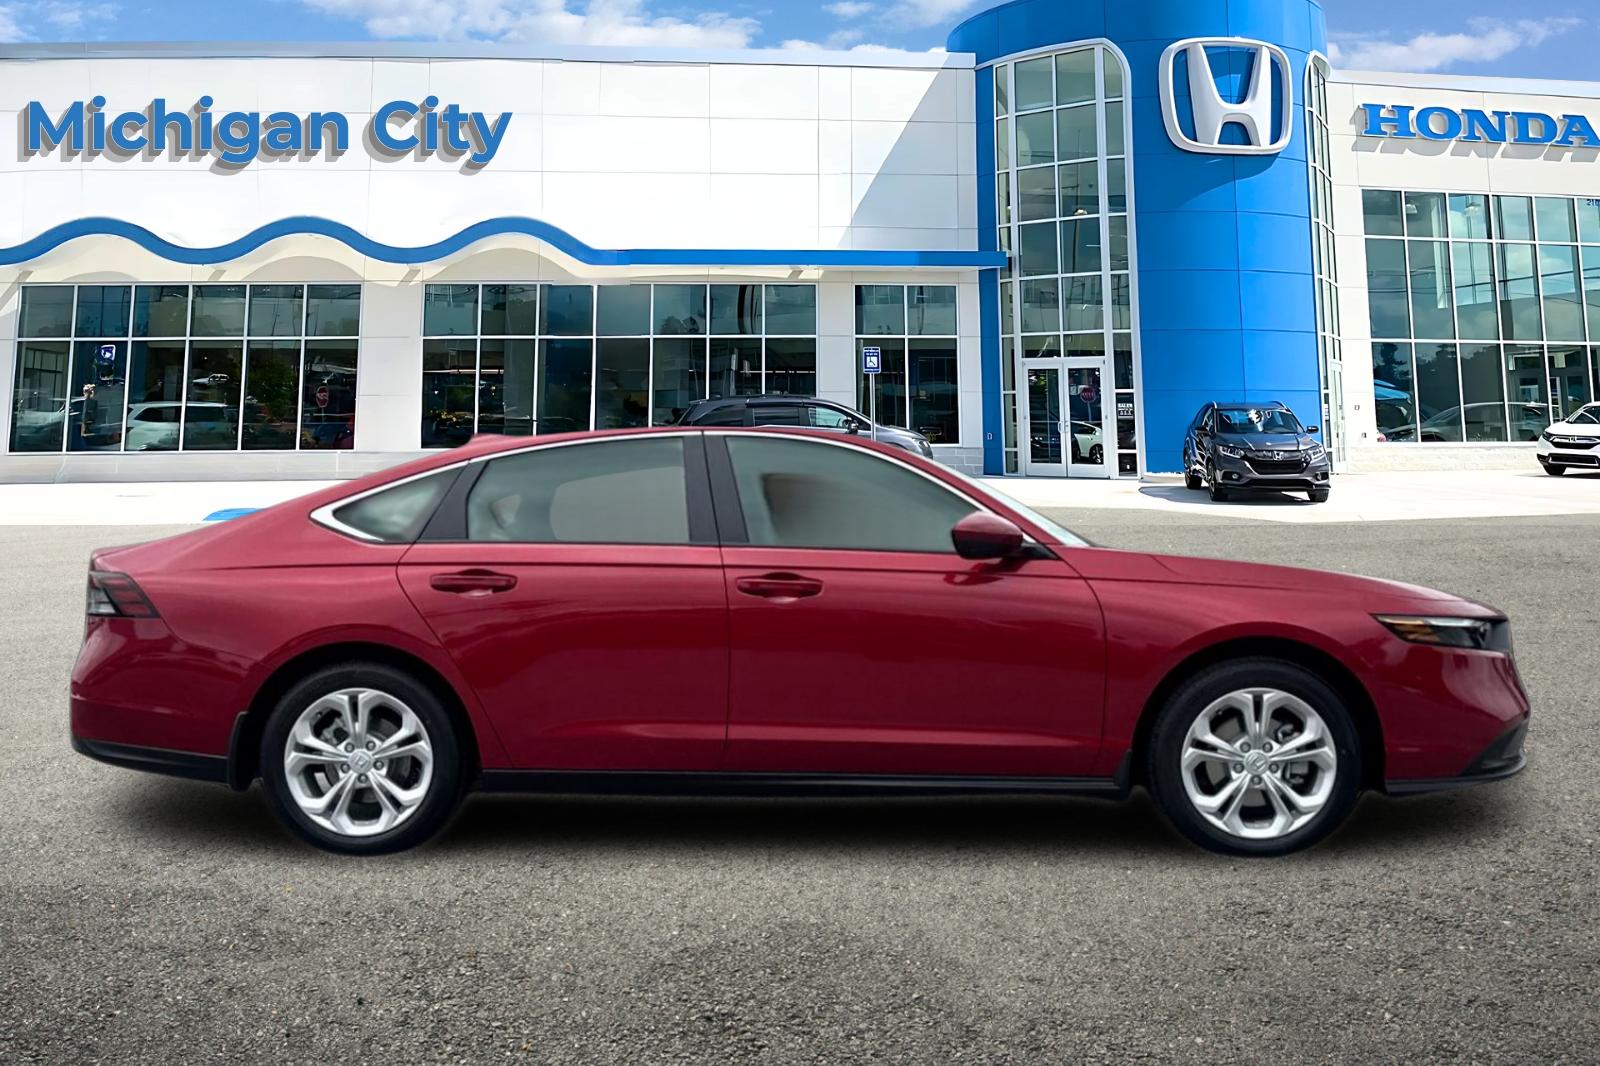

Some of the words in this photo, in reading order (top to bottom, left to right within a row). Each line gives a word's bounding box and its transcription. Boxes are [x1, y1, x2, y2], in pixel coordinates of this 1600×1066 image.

[28, 95, 349, 164] Michigan
[373, 95, 513, 164] City
[1361, 102, 1600, 147] HONDA
